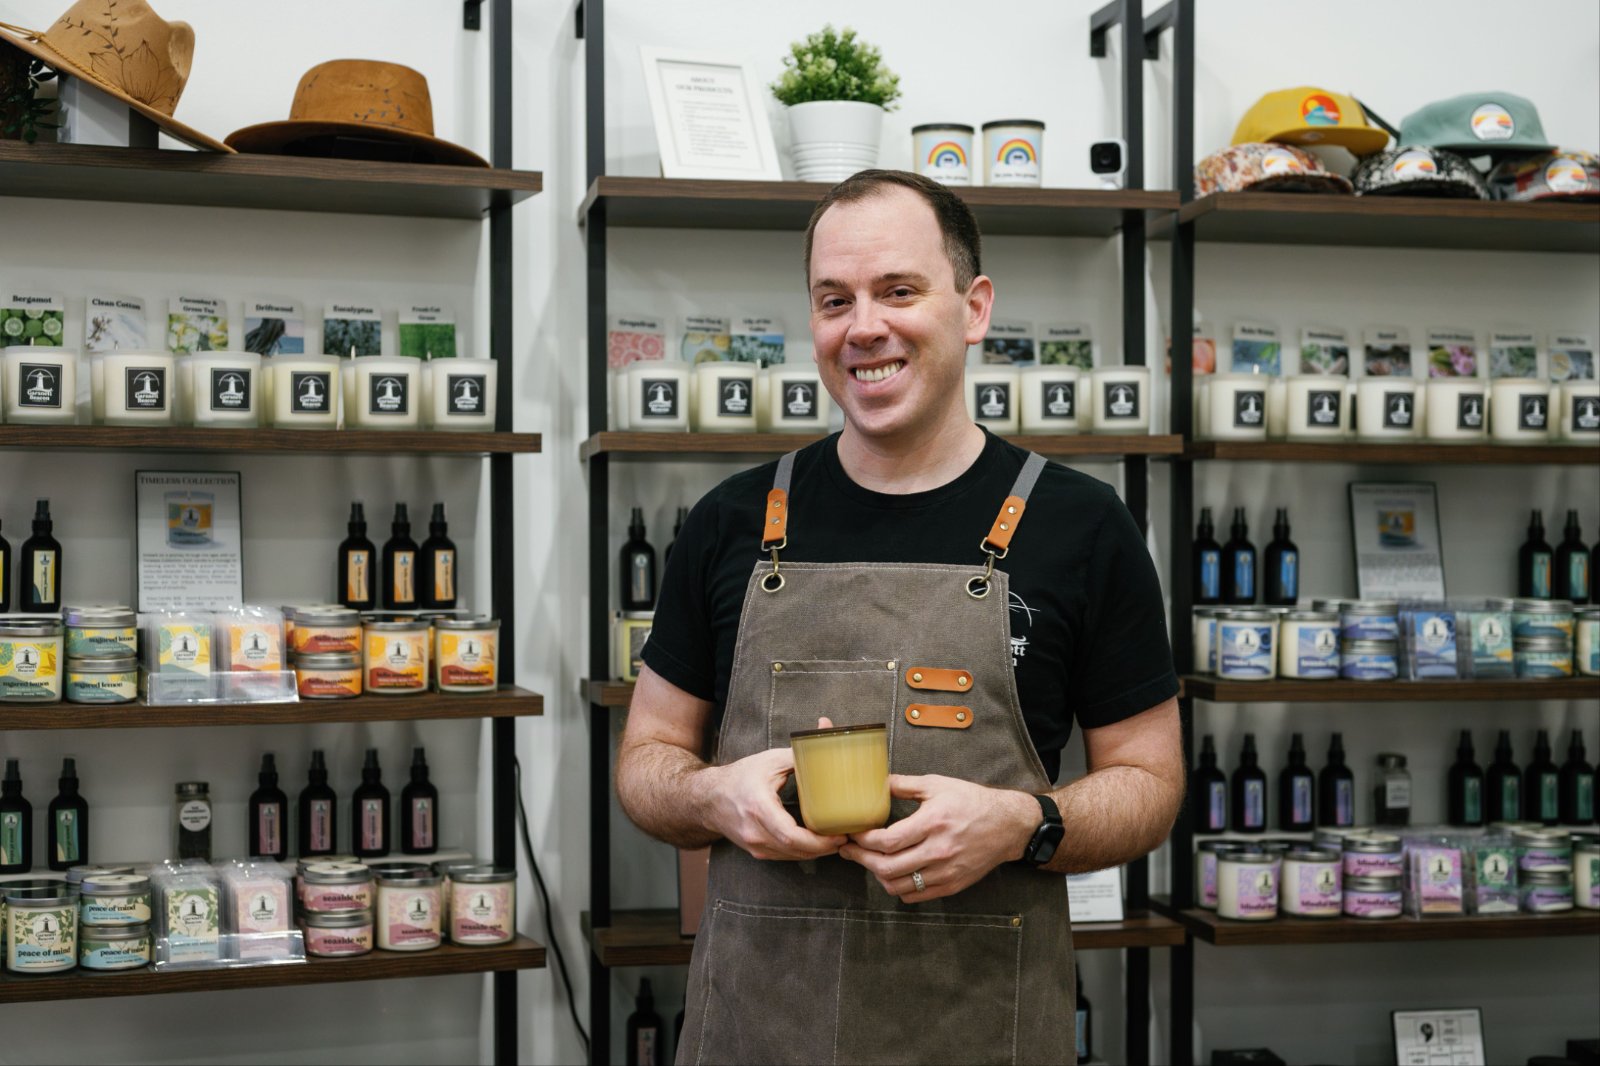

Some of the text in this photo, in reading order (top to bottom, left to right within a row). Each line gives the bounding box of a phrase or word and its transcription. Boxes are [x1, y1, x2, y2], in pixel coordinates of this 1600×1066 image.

[12, 295, 52, 306] Bergamot
[92, 298, 141, 310] Clean Cotton
[255, 304, 293, 313] Driftwood
[182, 476, 236, 485] COLLECTION
[52, 947, 72, 955] mind
